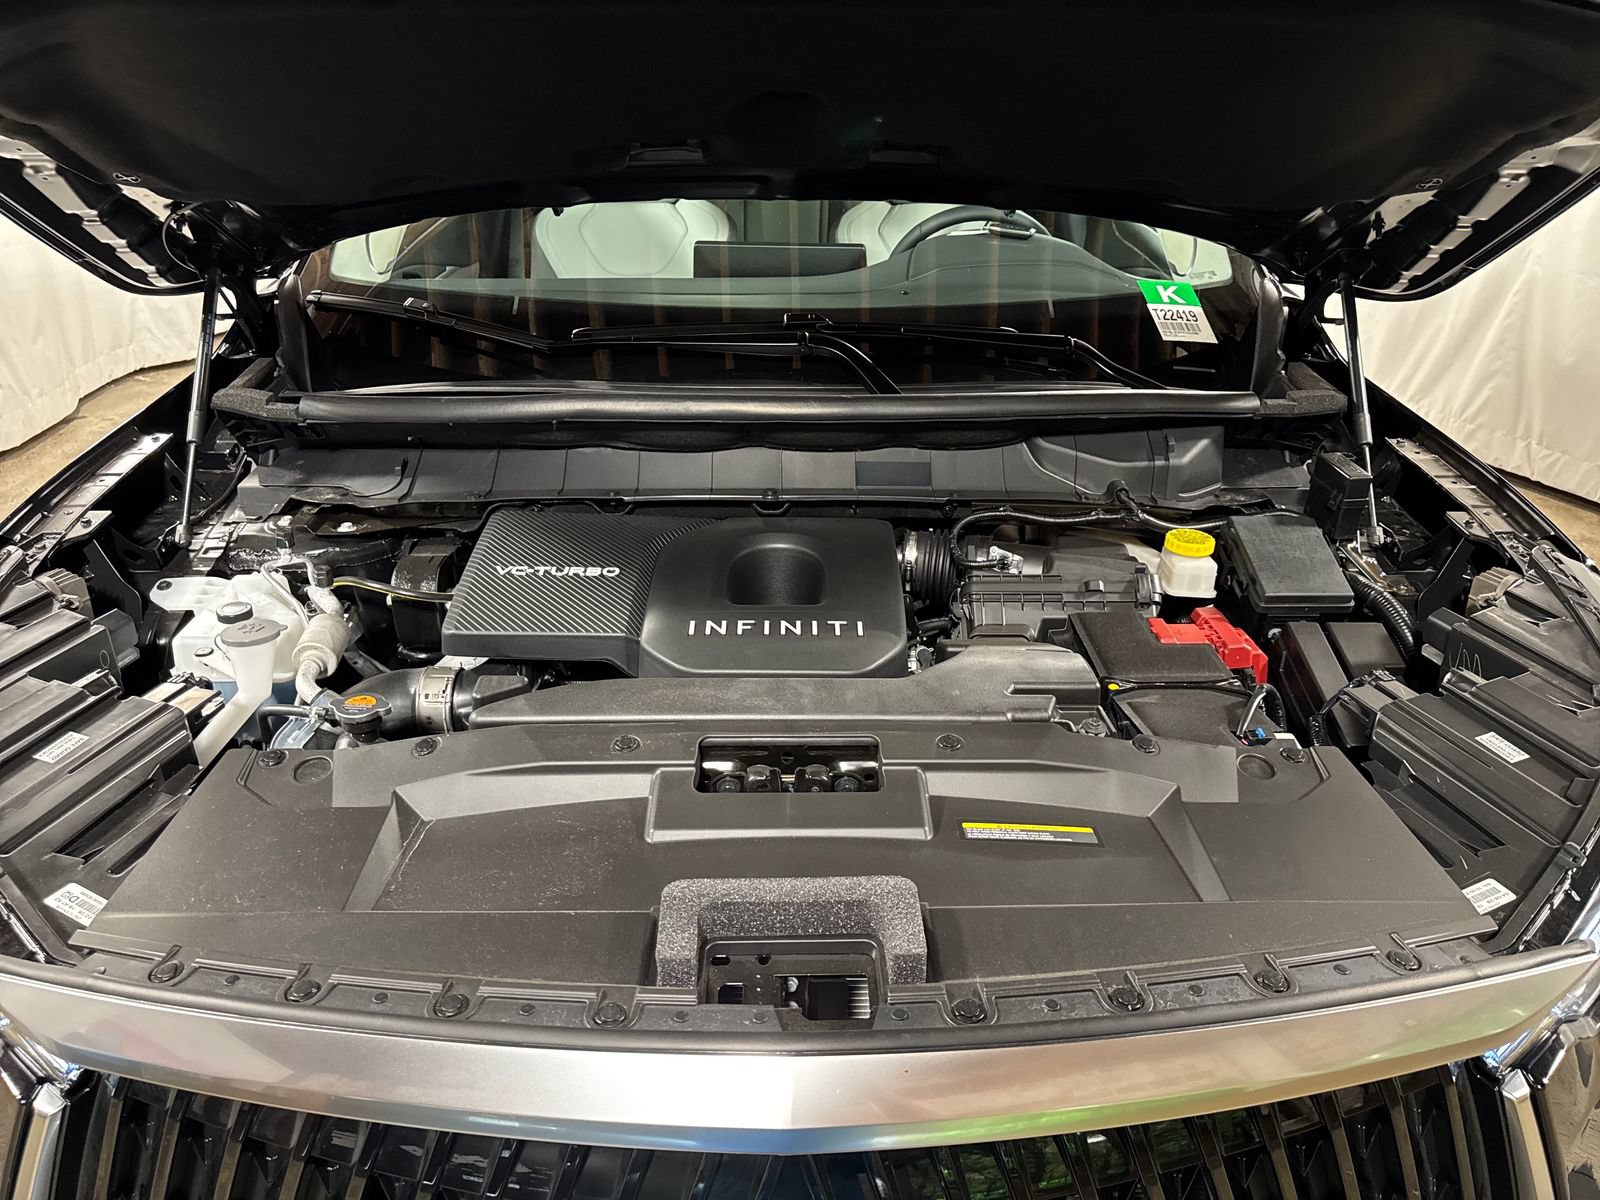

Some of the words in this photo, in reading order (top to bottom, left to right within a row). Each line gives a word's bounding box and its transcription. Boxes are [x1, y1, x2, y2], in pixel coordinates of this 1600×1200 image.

[1156, 285, 1186, 304] K
[1152, 308, 1198, 322] T22419
[495, 565, 620, 577] VC-TURBO
[688, 620, 864, 636] INFINITI
